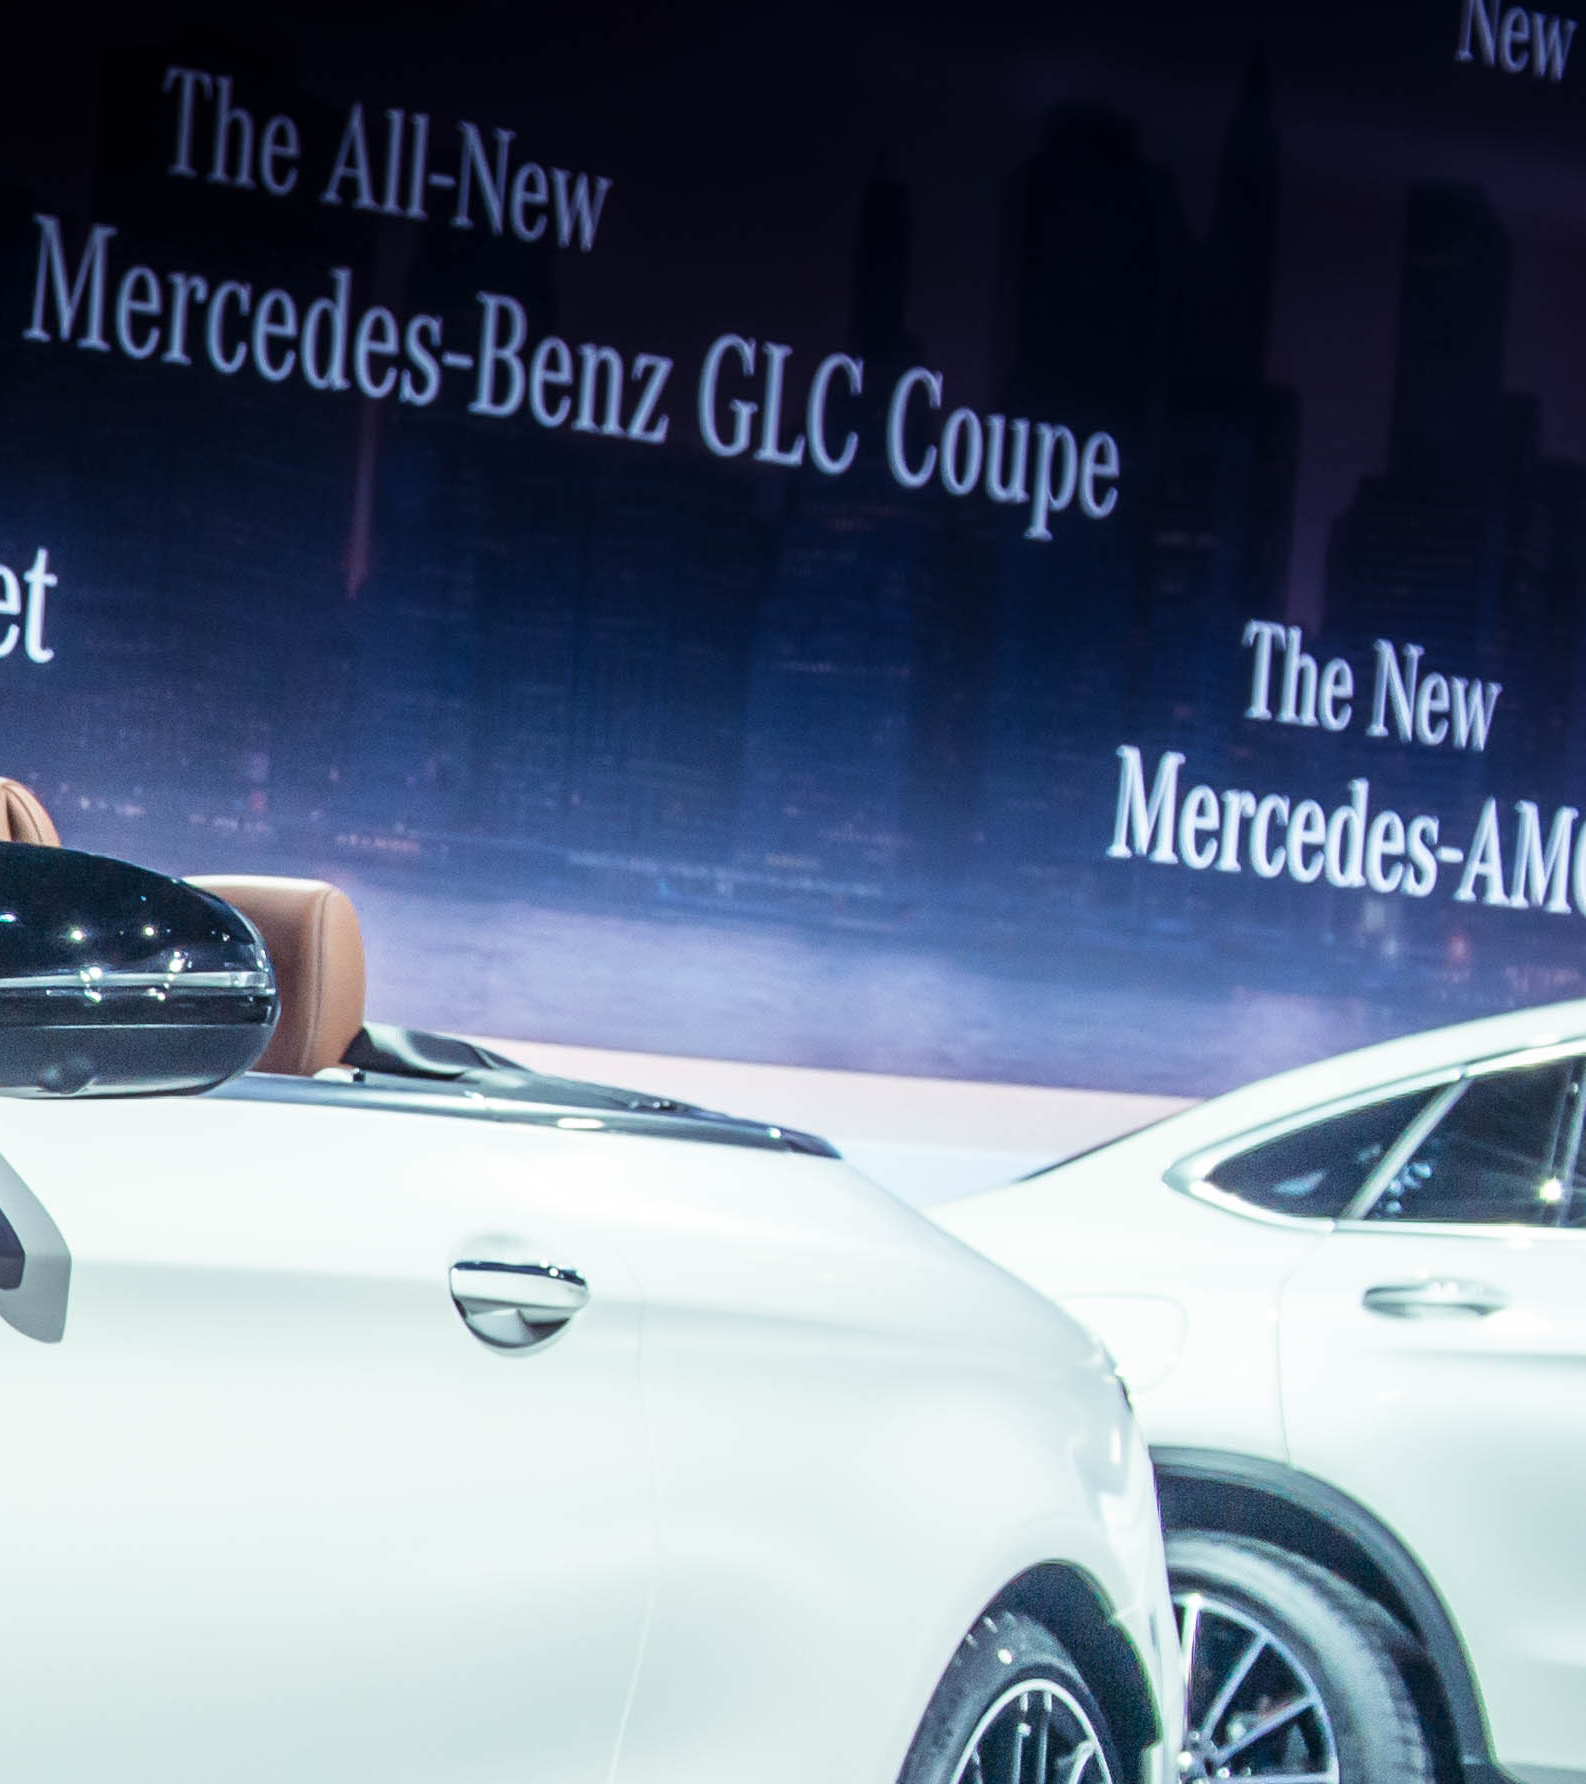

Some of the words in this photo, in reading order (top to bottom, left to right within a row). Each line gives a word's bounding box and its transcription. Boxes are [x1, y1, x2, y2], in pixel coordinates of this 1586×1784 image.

[1455, 0, 1578, 81] New
[165, 68, 299, 195] The
[322, 105, 612, 252] All-New
[25, 214, 671, 444] Mercedes-Benz
[698, 334, 864, 475] GLC
[886, 366, 1121, 541] Coupe
[1243, 618, 1353, 732] The
[1366, 638, 1503, 751] New
[1105, 744, 1586, 916] Mercedes-AM
